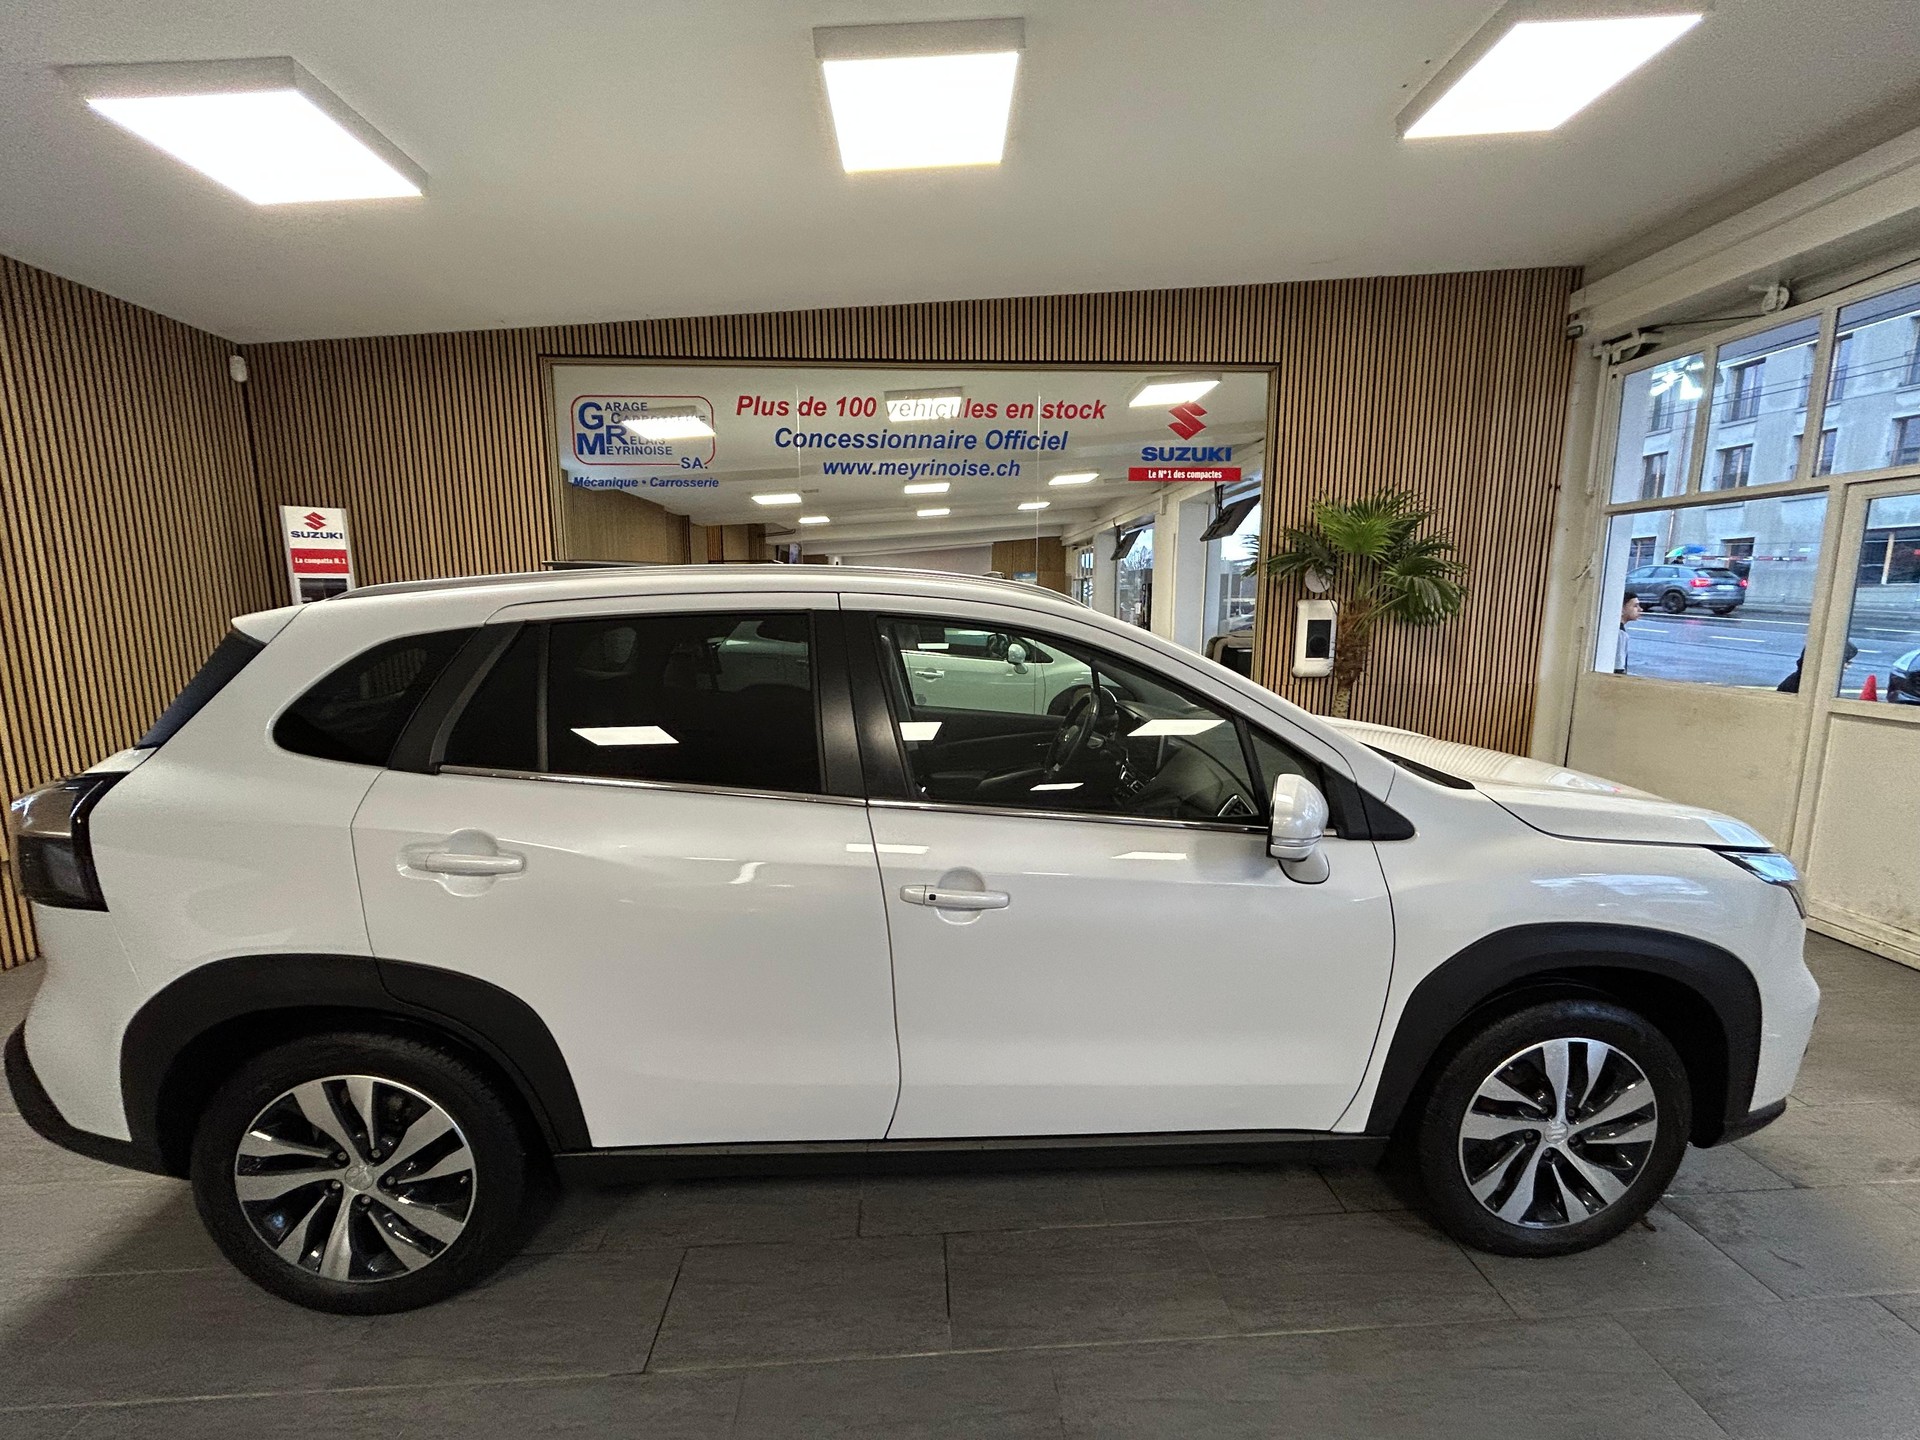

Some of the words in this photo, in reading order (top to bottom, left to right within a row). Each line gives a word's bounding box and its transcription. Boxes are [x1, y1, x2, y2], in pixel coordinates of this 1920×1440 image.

[736, 395, 790, 417] Plus
[798, 396, 827, 417] de
[836, 396, 877, 417] 100
[1006, 403, 1034, 419] en
[1041, 400, 1107, 419] stock
[577, 433, 673, 455] MEYRINOISE
[775, 427, 977, 449] Concessionnaire
[985, 429, 1068, 450] Officiel
[1141, 446, 1232, 462] SUZUKI
[823, 459, 1021, 480] www.meyrinoise.ch
[1148, 470, 1156, 479] Le
[1173, 470, 1185, 479] des
[1186, 470, 1222, 480] compactes
[573, 477, 638, 488] Mécanique
[650, 477, 719, 487] Carrosserie
[291, 531, 343, 539] SUZUKI
